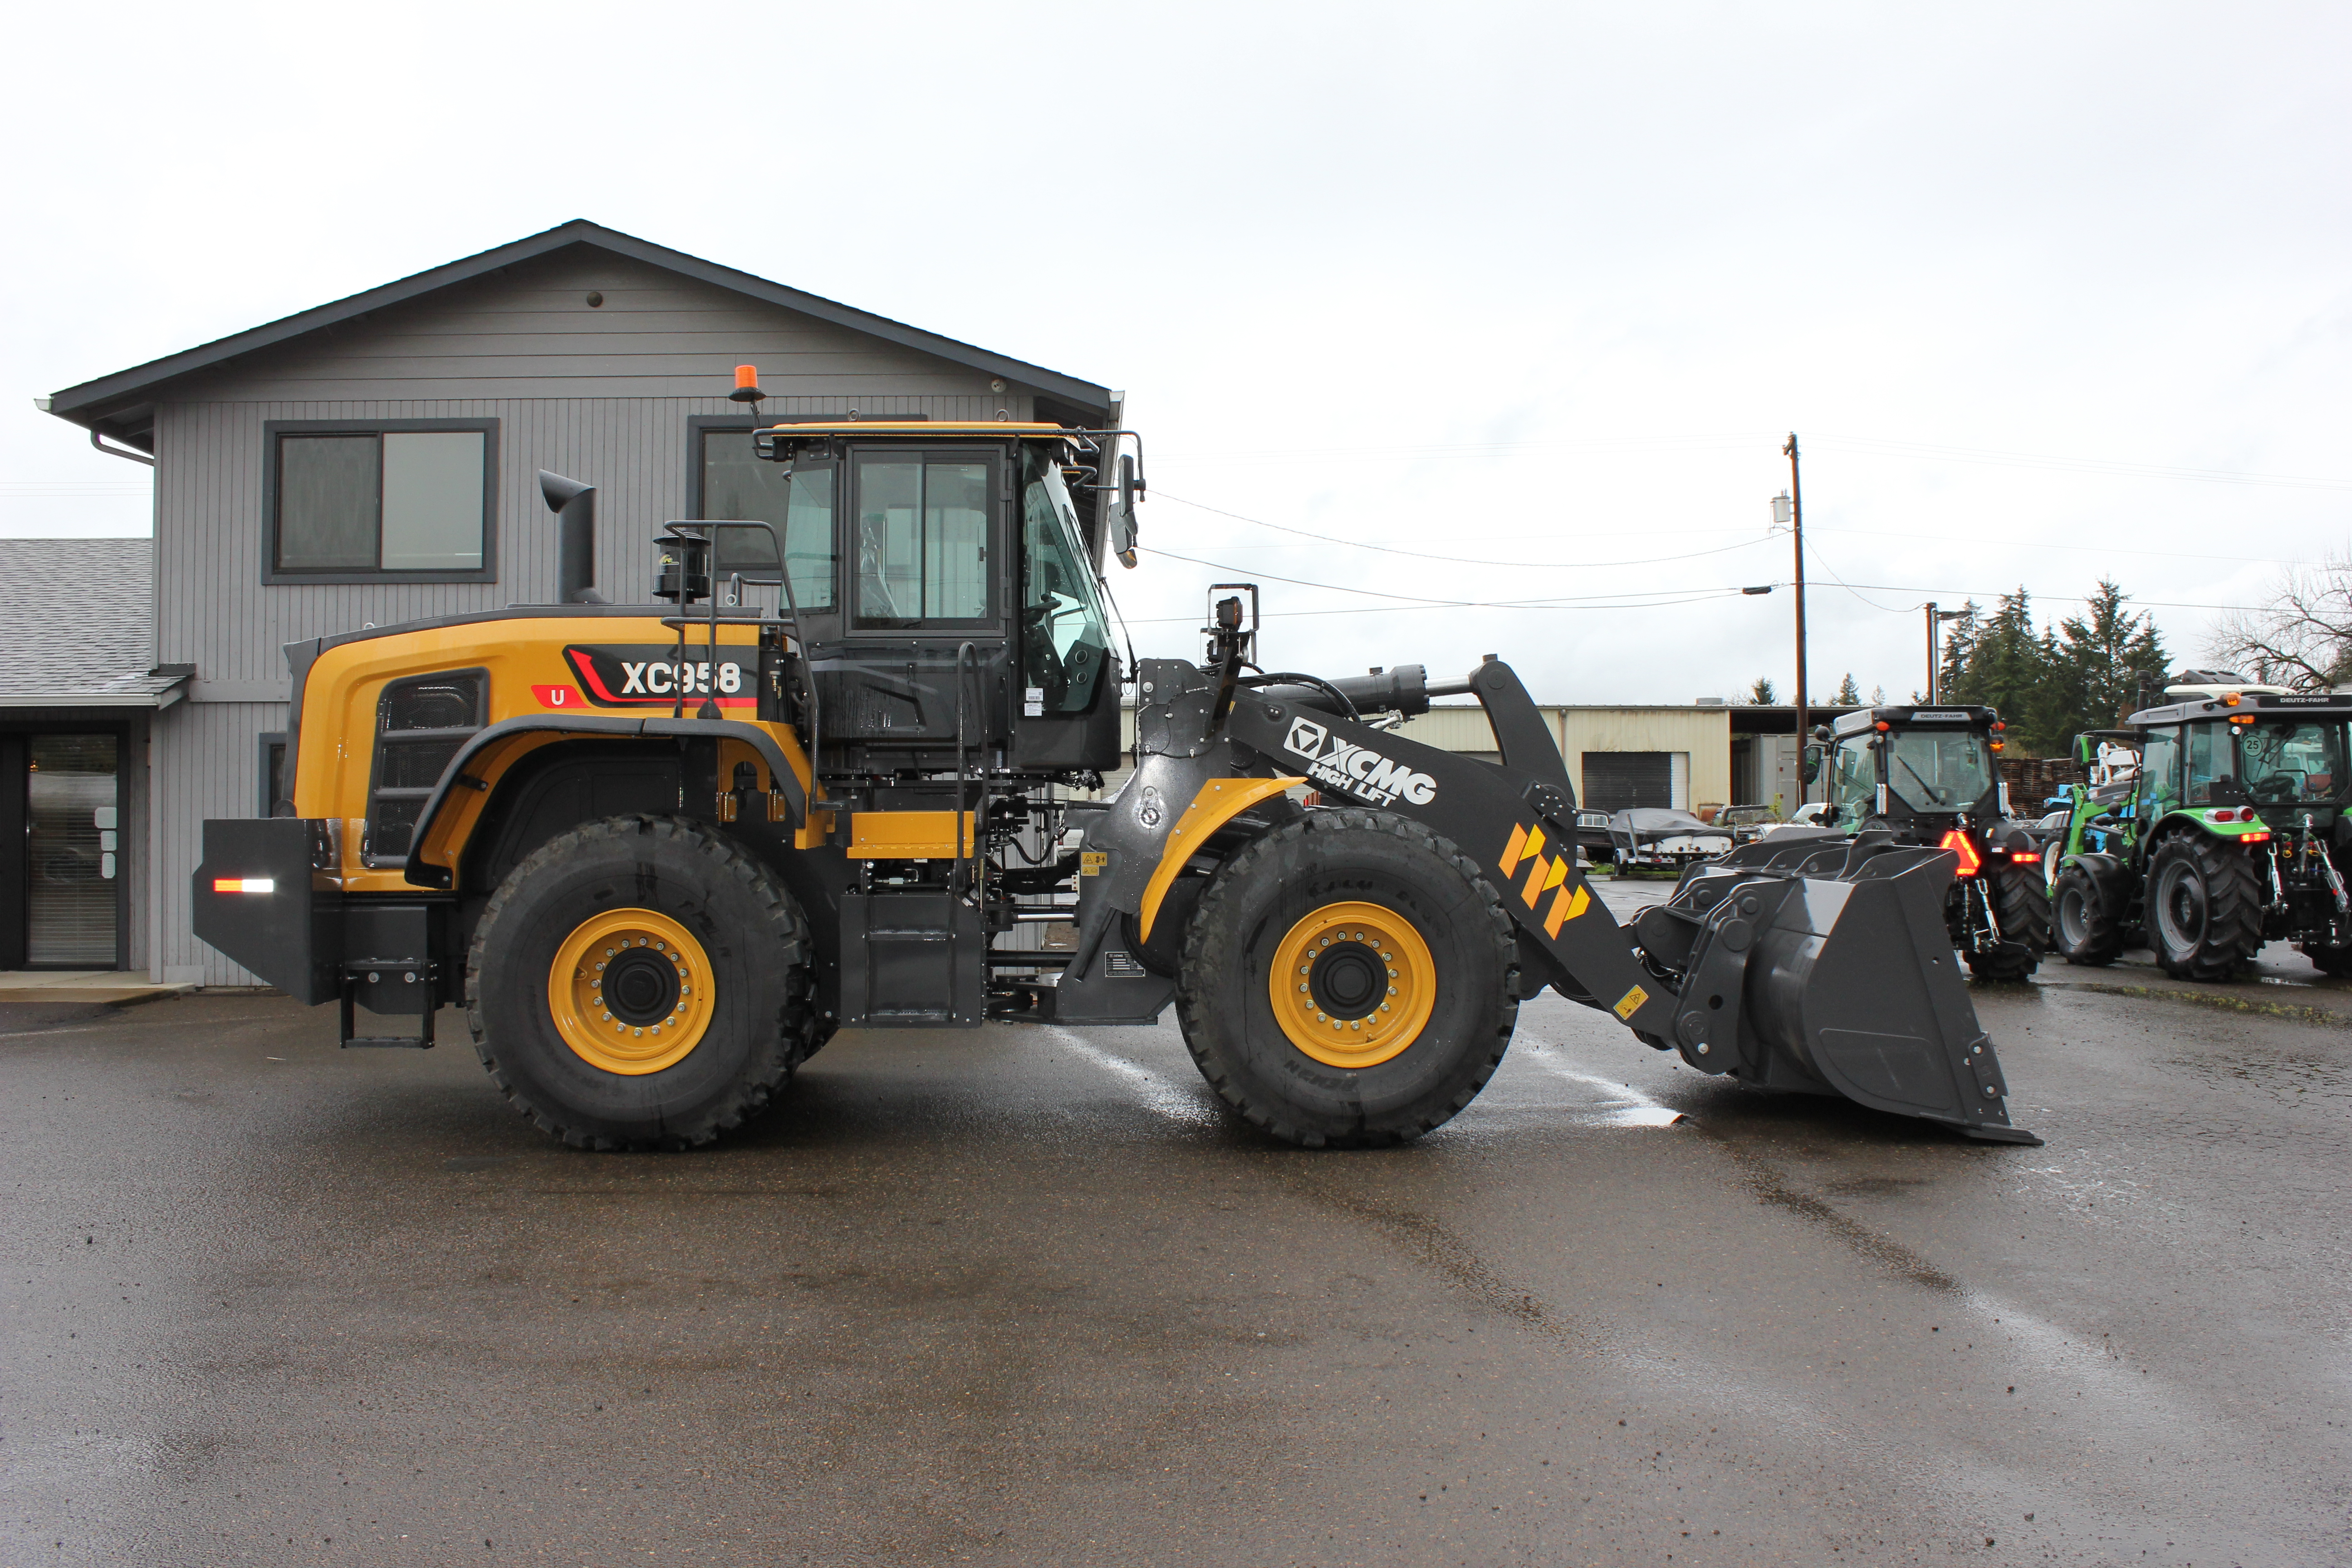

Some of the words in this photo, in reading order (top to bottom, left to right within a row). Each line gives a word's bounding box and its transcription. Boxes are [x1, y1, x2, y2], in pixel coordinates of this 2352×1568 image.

[622, 662, 741, 694] XC958
[550, 689, 565, 706] U
[2246, 740, 2259, 750] 25
[1306, 762, 1355, 790] HIGH
[1353, 781, 1397, 807] LIFT
[1315, 735, 1438, 805] XCMG
